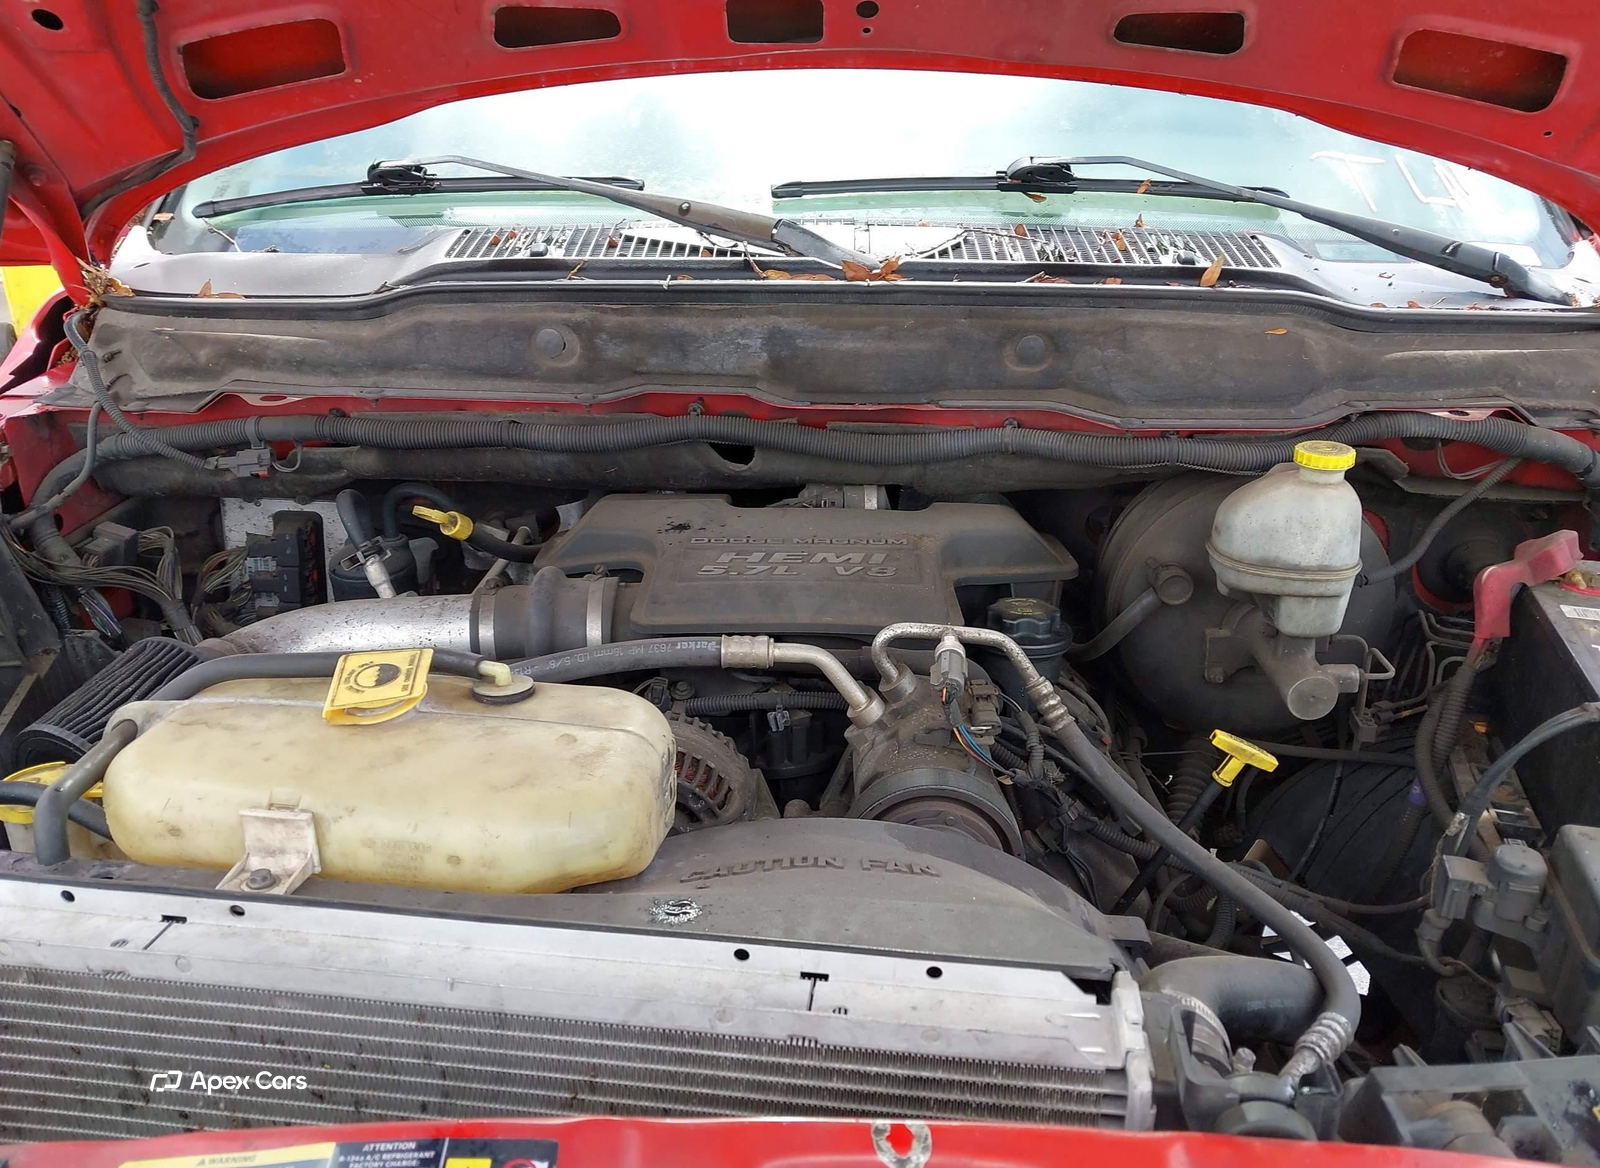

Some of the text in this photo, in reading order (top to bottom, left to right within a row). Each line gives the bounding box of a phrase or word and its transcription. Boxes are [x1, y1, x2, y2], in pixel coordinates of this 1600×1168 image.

[690, 536, 908, 546] DODGE MAGNUM
[715, 551, 889, 565] HEMI
[697, 564, 898, 577] 5.7L V8
[628, 645, 644, 655] MP
[648, 643, 672, 654] 7637
[675, 640, 717, 652] Parker
[593, 646, 623, 658] 16mm
[679, 855, 943, 884] CAUTION FAN
[362, 1141, 417, 1152] ATTENTION
[207, 1154, 257, 1165] WARNING
[381, 1151, 436, 1160] REFRIGERANT
